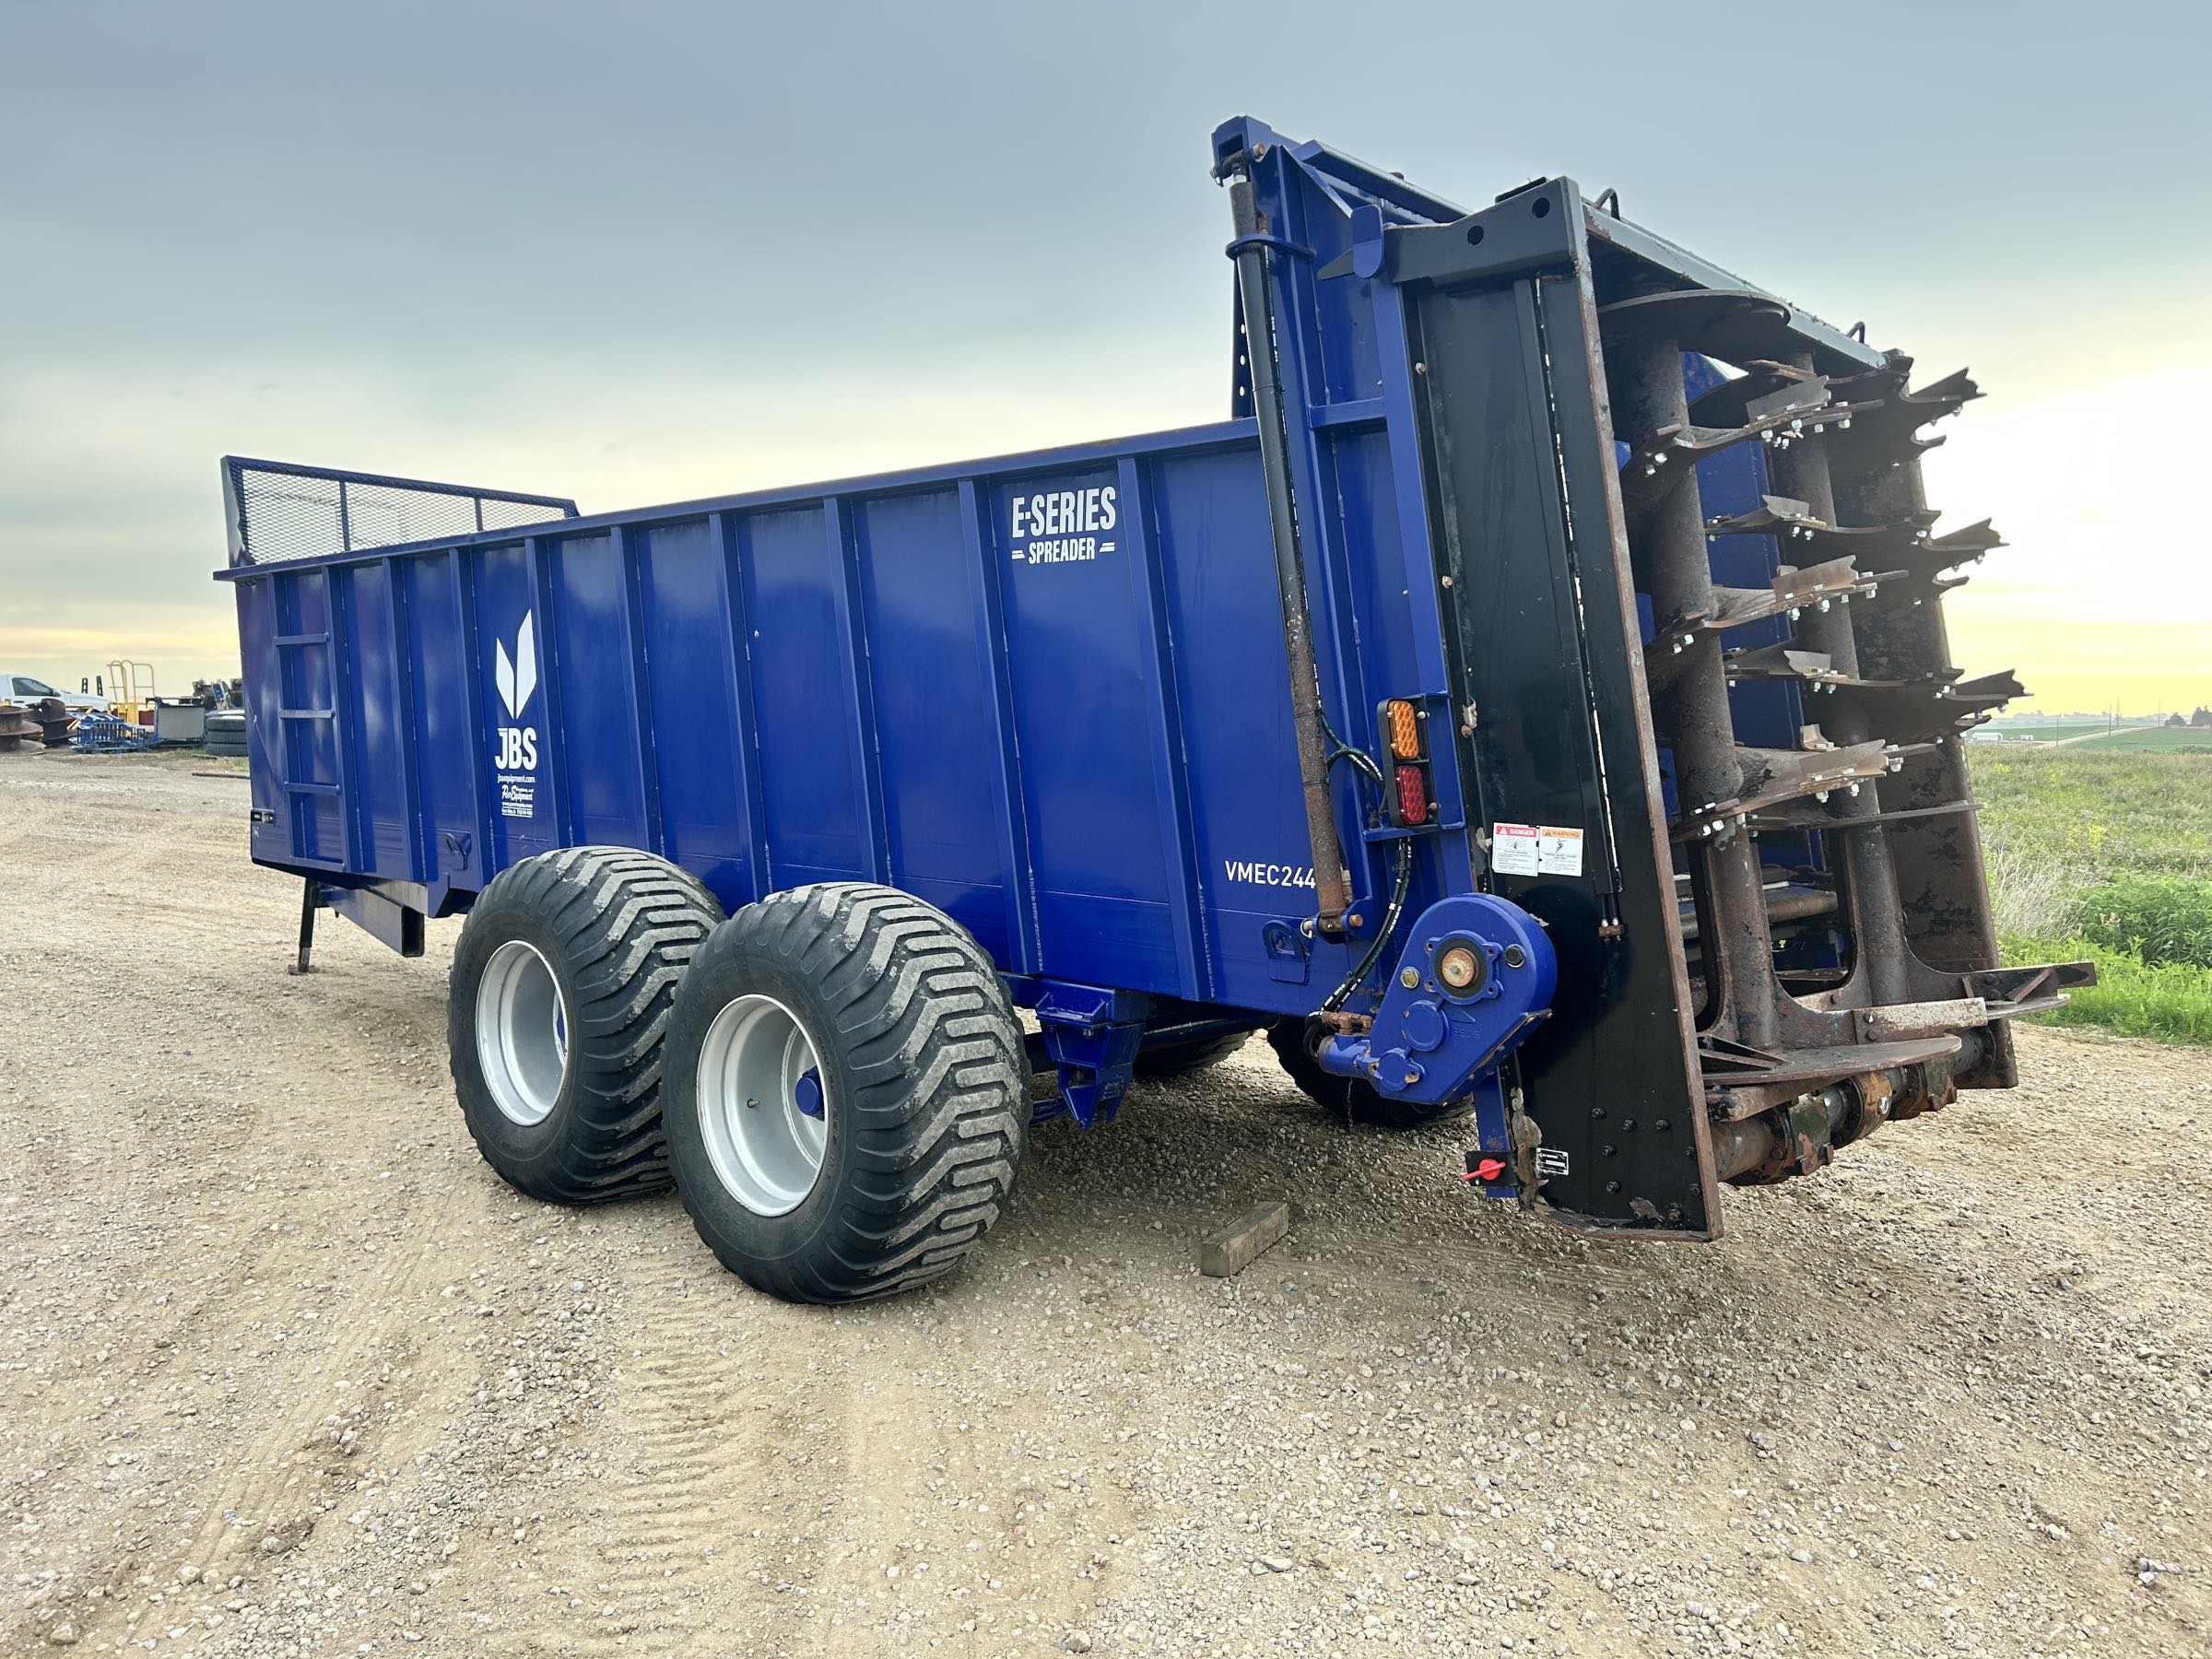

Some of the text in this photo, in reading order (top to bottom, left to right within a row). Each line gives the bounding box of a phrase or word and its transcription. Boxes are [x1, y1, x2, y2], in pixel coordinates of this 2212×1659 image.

[1012, 487, 1116, 537] E-SERIES
[1029, 537, 1095, 564] SPREADER
[495, 727, 536, 771] JBS
[1551, 830, 1580, 838] WARNING
